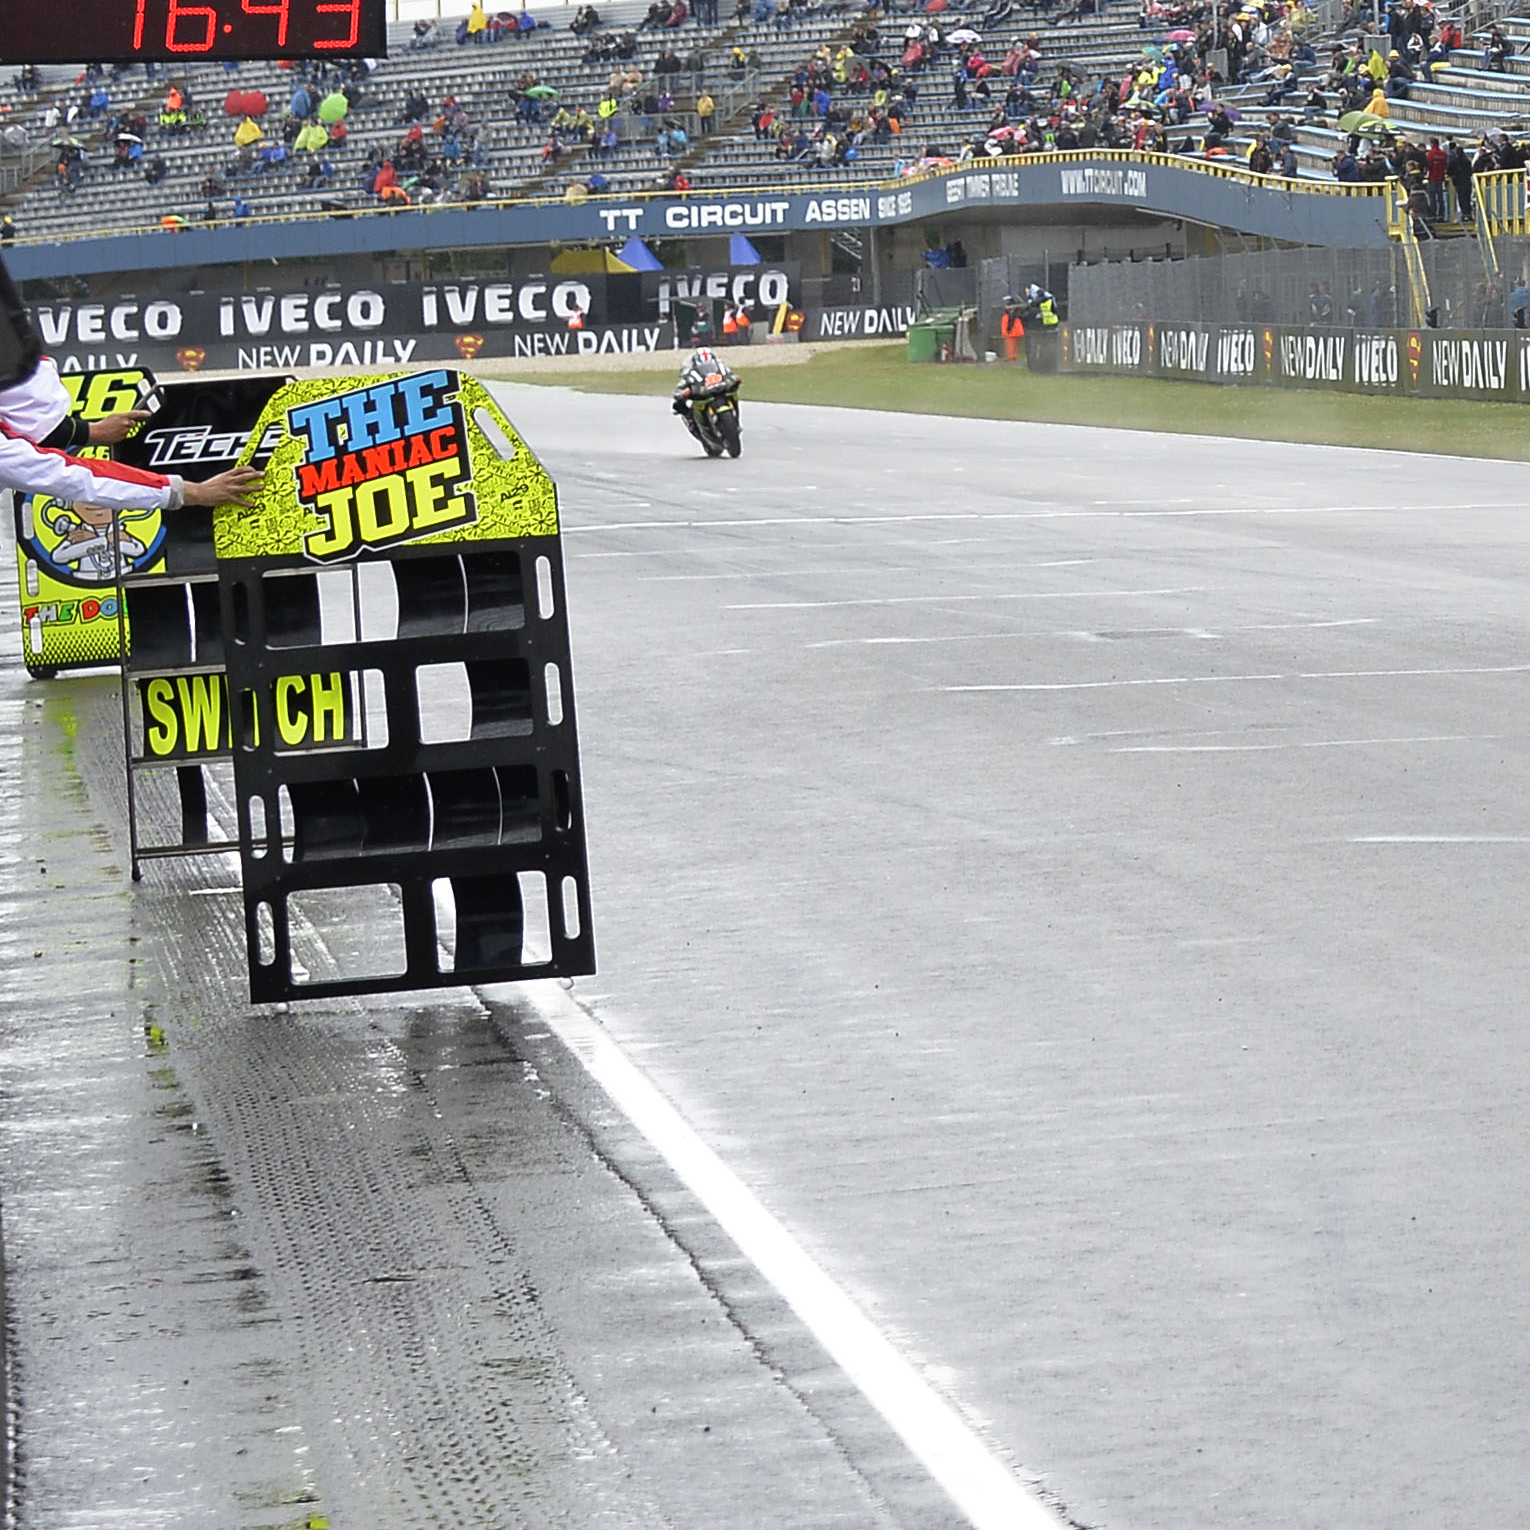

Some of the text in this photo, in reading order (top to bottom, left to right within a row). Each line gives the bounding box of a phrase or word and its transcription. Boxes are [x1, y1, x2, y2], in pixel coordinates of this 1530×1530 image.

[599, 208, 644, 231] TT
[665, 202, 789, 228] CIRCUIT
[805, 197, 871, 223] ASSEN
[25, 300, 183, 346] VECO
[219, 289, 386, 337] IVECO
[421, 281, 592, 327] IVECO
[820, 310, 861, 337] NEW
[238, 338, 416, 370] NEW DAILY
[513, 326, 660, 358] NEW DAILY
[1160, 329, 1255, 376] NEW DAILY IVECO
[1280, 334, 1398, 387] NEW DAILY IVECO
[1432, 339, 1461, 386] NEW
[1462, 339, 1507, 390] DAILY
[290, 370, 454, 463] THE
[299, 426, 459, 498] MANIAC
[307, 456, 467, 557] JOE
